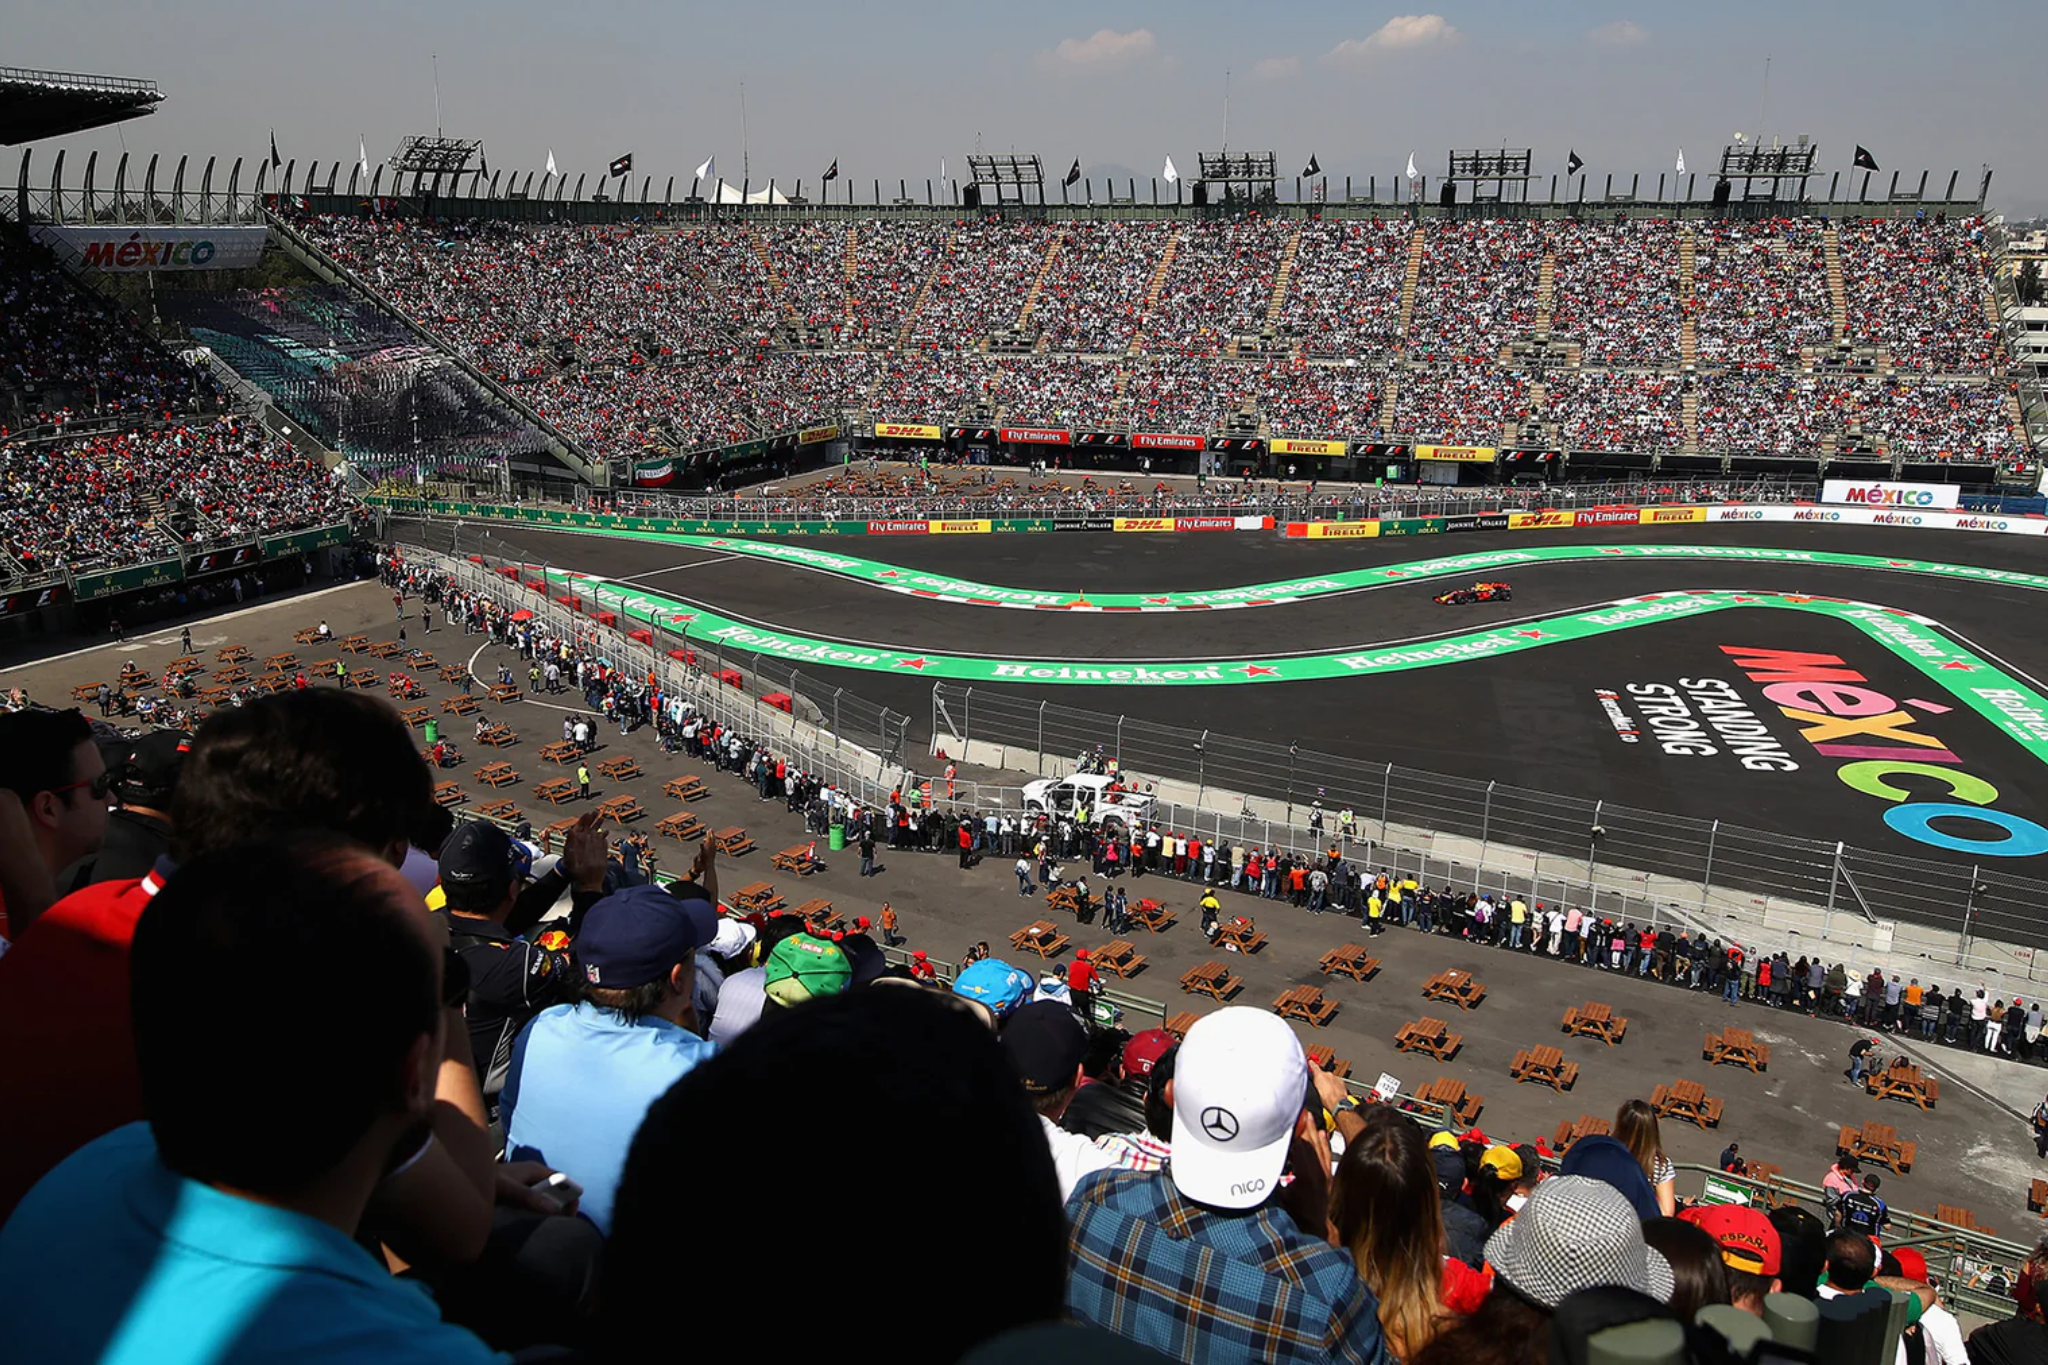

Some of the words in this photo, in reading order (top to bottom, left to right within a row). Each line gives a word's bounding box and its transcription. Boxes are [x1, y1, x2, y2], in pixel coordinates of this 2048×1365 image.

[807, 430, 835, 441] DHL
[886, 426, 925, 436] DHL
[1008, 431, 1023, 441] Fly
[1024, 431, 1061, 441] Emirates
[1140, 437, 1156, 447] Fly
[1157, 437, 1196, 447] Emirates
[1287, 442, 1328, 453] PIRELLI
[1433, 448, 1476, 459] PIRELLI
[1519, 514, 1564, 526] DHL
[1578, 513, 1595, 524] Fly
[1596, 510, 1638, 521] Emirates
[1653, 510, 1694, 521] PIRELLI
[870, 522, 885, 532] Fly
[887, 522, 927, 531] Emirates
[941, 522, 979, 531] PIRELLI
[1124, 520, 1165, 530] DHL
[1177, 519, 1192, 529] Fly
[1193, 519, 1232, 528] Emirates
[1446, 521, 1475, 530] JOHNNIE
[1481, 519, 1507, 527] WALKER
[1322, 525, 1366, 536] PIRELLI
[317, 539, 340, 548] ROLEX
[278, 546, 301, 556] ROLEX
[143, 574, 170, 586] ROLEX
[94, 584, 122, 596] ROLEX
[708, 625, 881, 664] Heineken
[1334, 634, 1521, 670] Heineken
[991, 664, 1223, 680] Heineken
[1970, 687, 2048, 741] Heine
[1626, 683, 1720, 757] STRONG
[1679, 678, 1800, 771] STANDING
